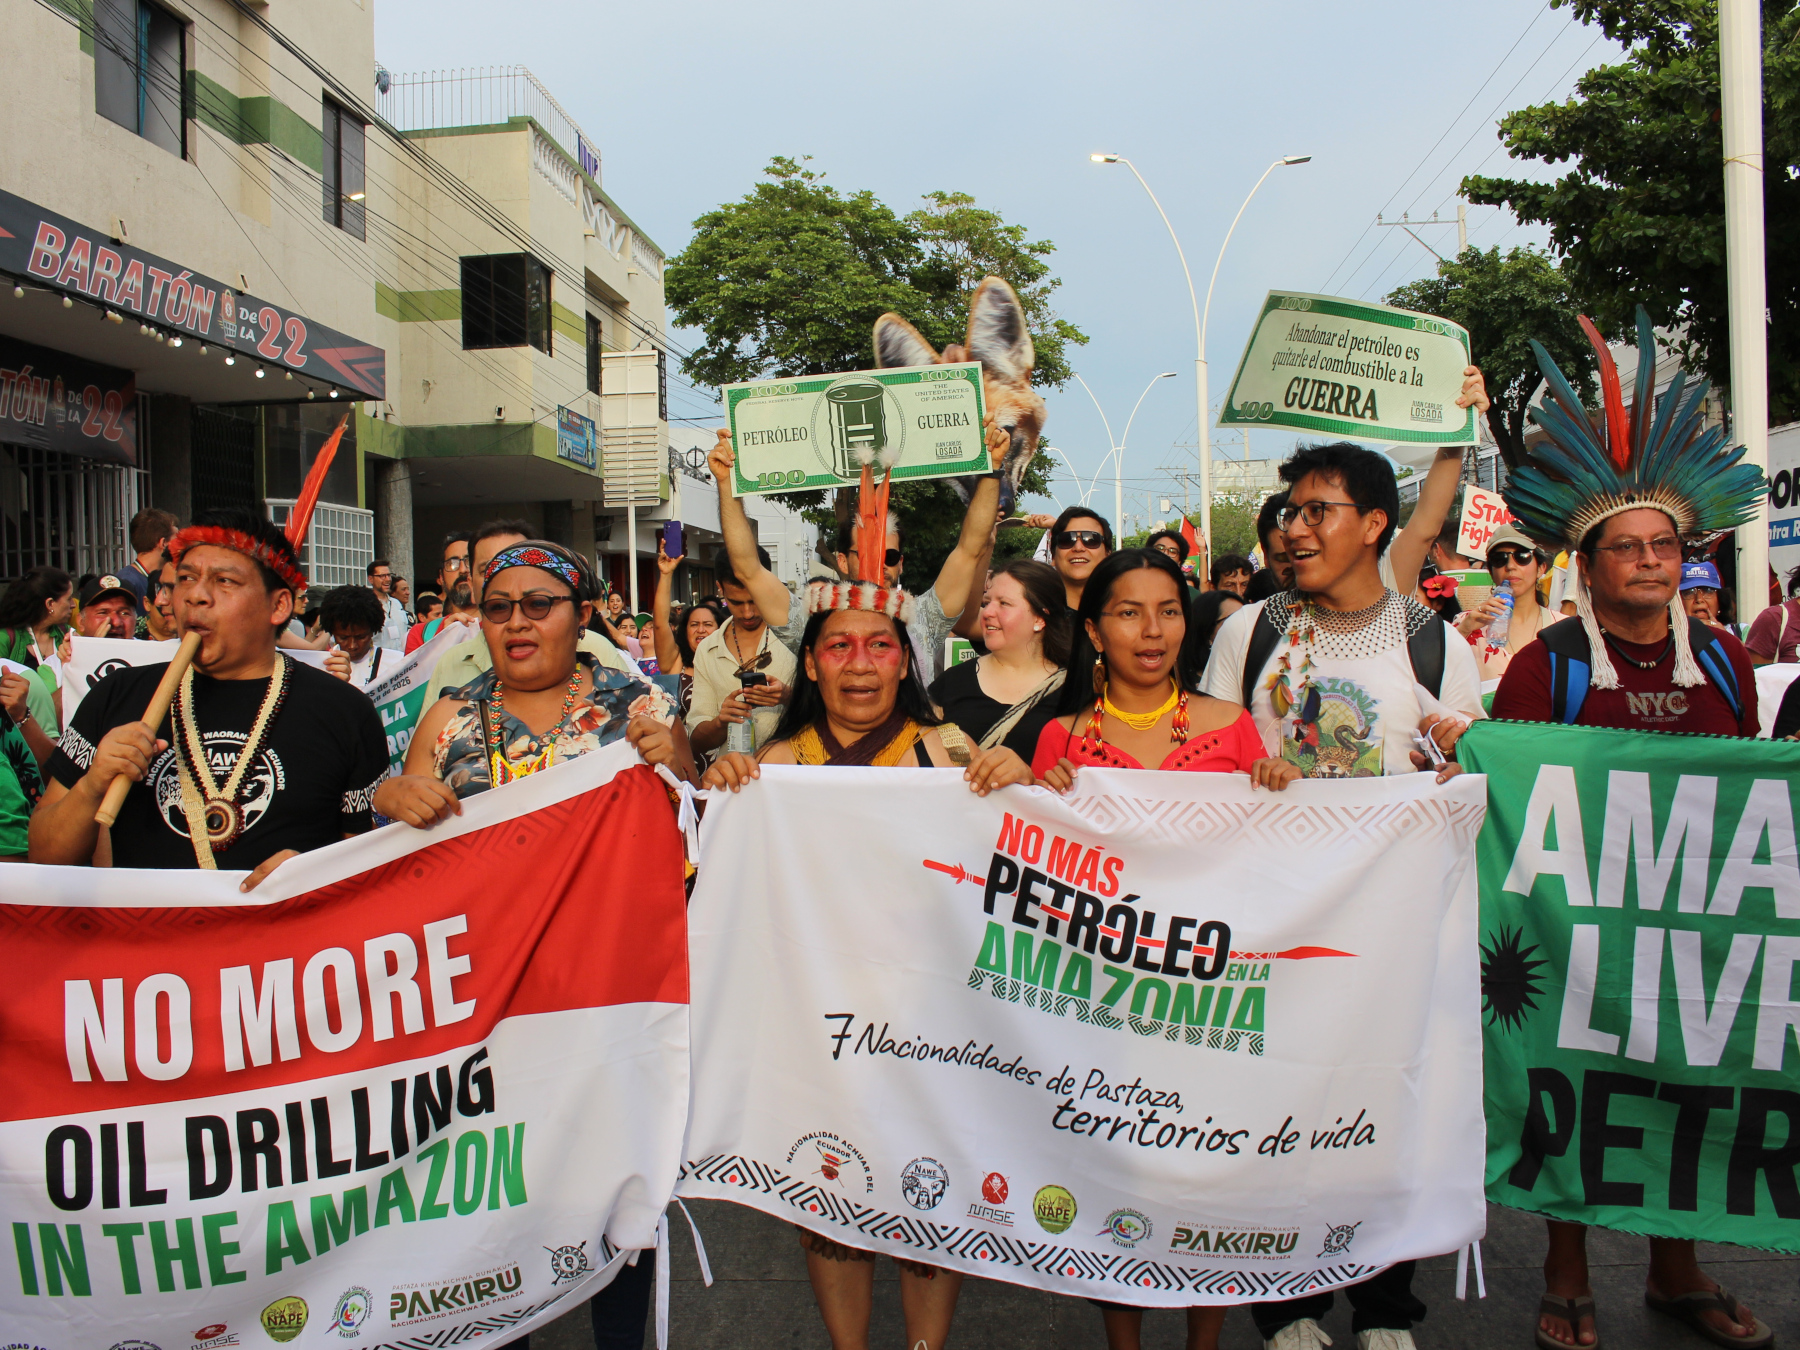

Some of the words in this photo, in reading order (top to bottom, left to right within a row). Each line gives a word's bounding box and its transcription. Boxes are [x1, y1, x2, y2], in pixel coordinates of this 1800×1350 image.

[27, 220, 217, 335] BARATÓN
[239, 306, 258, 324] DE
[1278, 297, 1312, 311] 100
[239, 325, 256, 342] LA
[257, 306, 308, 368] 22
[1412, 318, 1461, 340] 100
[1285, 322, 1337, 347] Abandonar
[1338, 332, 1349, 349] el
[1349, 333, 1402, 359] petróleo
[1405, 345, 1420, 362] es
[920, 369, 967, 382] 100
[1272, 347, 1309, 371] quitarle
[1309, 350, 1319, 369] el
[1320, 354, 1396, 383] combustible
[1399, 372, 1407, 384] a
[1411, 366, 1423, 387] la
[68, 390, 82, 405] DE
[748, 383, 797, 398] 100
[932, 394, 964, 402] AMERICA
[1284, 376, 1379, 421] GUERRA
[68, 409, 80, 423] LA
[81, 384, 123, 441] 22
[1236, 401, 1273, 420] 100
[1410, 407, 1442, 419] LOSADA
[1425, 402, 1442, 410] CARLOS
[917, 411, 970, 430] GUERRA
[742, 425, 808, 447] PETRÓLEO
[936, 446, 962, 456] LOSADA
[757, 470, 806, 488] 100
[392, 676, 411, 691] 2026
[381, 700, 408, 728] LA
[1626, 690, 1689, 716] NYC
[203, 731, 250, 741] WAORAN
[145, 746, 177, 786] NACIONA
[266, 748, 285, 791] ECUADOR
[997, 811, 1043, 868] NO
[1045, 836, 1125, 898] MÁS
[982, 853, 1231, 981] PETRÓLEO
[1226, 962, 1250, 982] EN
[1252, 963, 1271, 982] LA
[64, 972, 195, 1082] NO
[220, 913, 477, 1073] MORE
[967, 920, 1267, 1056] AMAZONIA
[824, 1012, 855, 1061] 7
[856, 1020, 1043, 1088] Nacionalidades
[1046, 1064, 1078, 1098] de
[1079, 1067, 1186, 1114] Pastaza,
[45, 1120, 168, 1212] OIL
[185, 1047, 496, 1201] DRILLING
[1051, 1100, 1251, 1158] territorios
[1256, 1118, 1299, 1158] de
[1309, 1107, 1376, 1152] vida
[816, 1140, 851, 1159] ECUADOR
[786, 1131, 839, 1164] NACIONALIDAD
[841, 1139, 870, 1173] ACHUAR
[866, 1176, 874, 1193] DEL
[12, 1221, 92, 1297] IN
[102, 1211, 248, 1293] THE
[264, 1121, 528, 1276] AMAZON
[1037, 1205, 1070, 1220] NAPE
[1177, 1221, 1208, 1229] PASTAZA
[1170, 1227, 1300, 1255] PAKKIRU
[1168, 1249, 1221, 1259] NACIONALIDAD
[420, 1280, 440, 1288] KIKIN
[442, 1274, 473, 1284] KICHWA
[475, 1260, 518, 1277] RUNAKUNA
[389, 1266, 522, 1321] PAKKIRU
[267, 1313, 302, 1326] NAPE
[391, 1312, 446, 1328] NACIONALIDAD
[448, 1305, 478, 1316] KICHWA
[492, 1290, 524, 1304] PASTAZA
[338, 1329, 360, 1338] NASHIE
